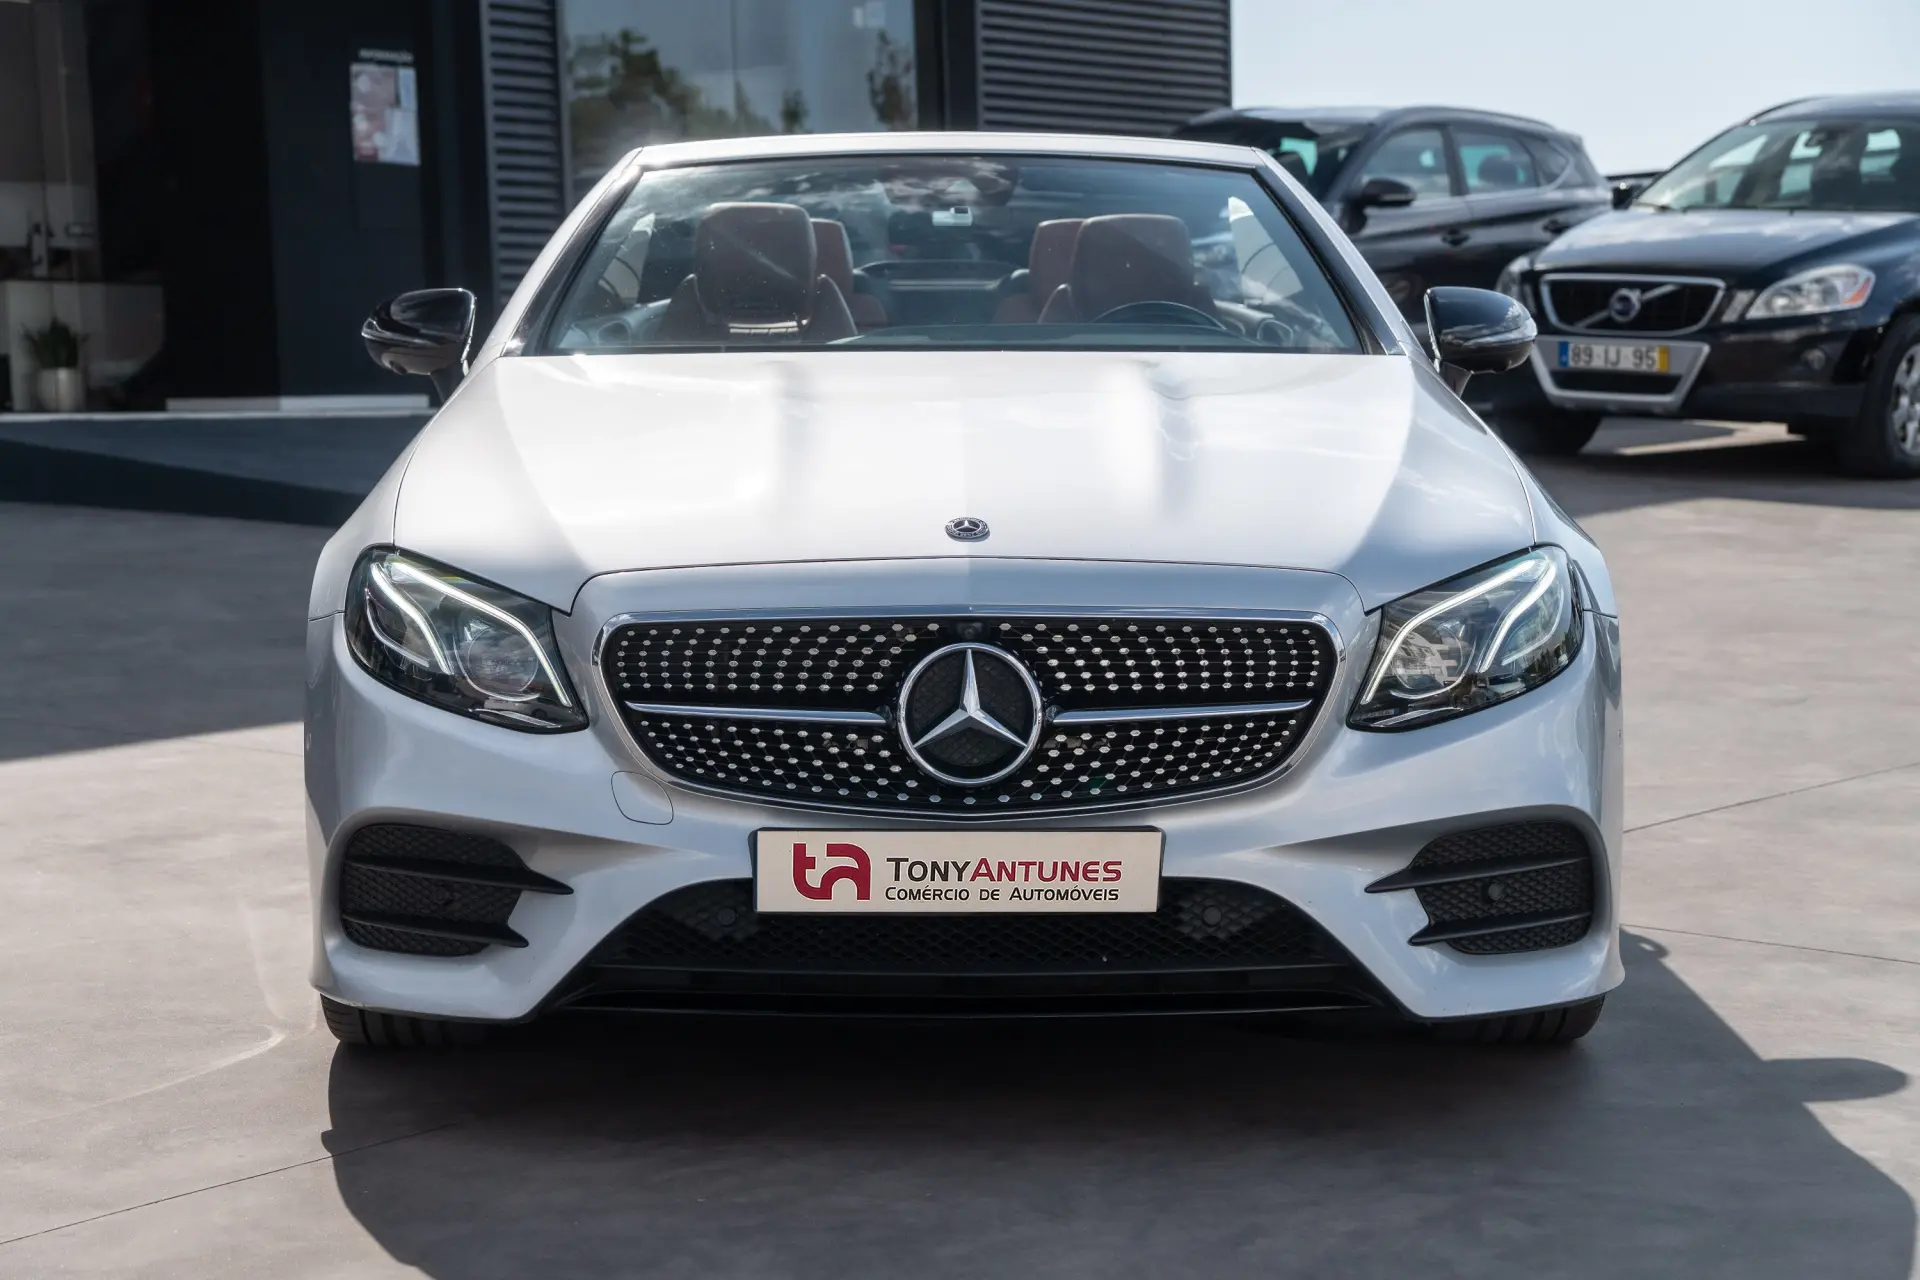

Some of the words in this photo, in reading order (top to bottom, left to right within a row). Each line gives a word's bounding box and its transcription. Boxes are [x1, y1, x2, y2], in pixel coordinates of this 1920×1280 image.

[1571, 345, 1594, 365] 89
[1632, 347, 1657, 369] 95
[884, 885, 970, 901] COMÉRCIO
[979, 888, 1001, 901] DE
[1009, 885, 1120, 901] AUTOMÓVEIS
